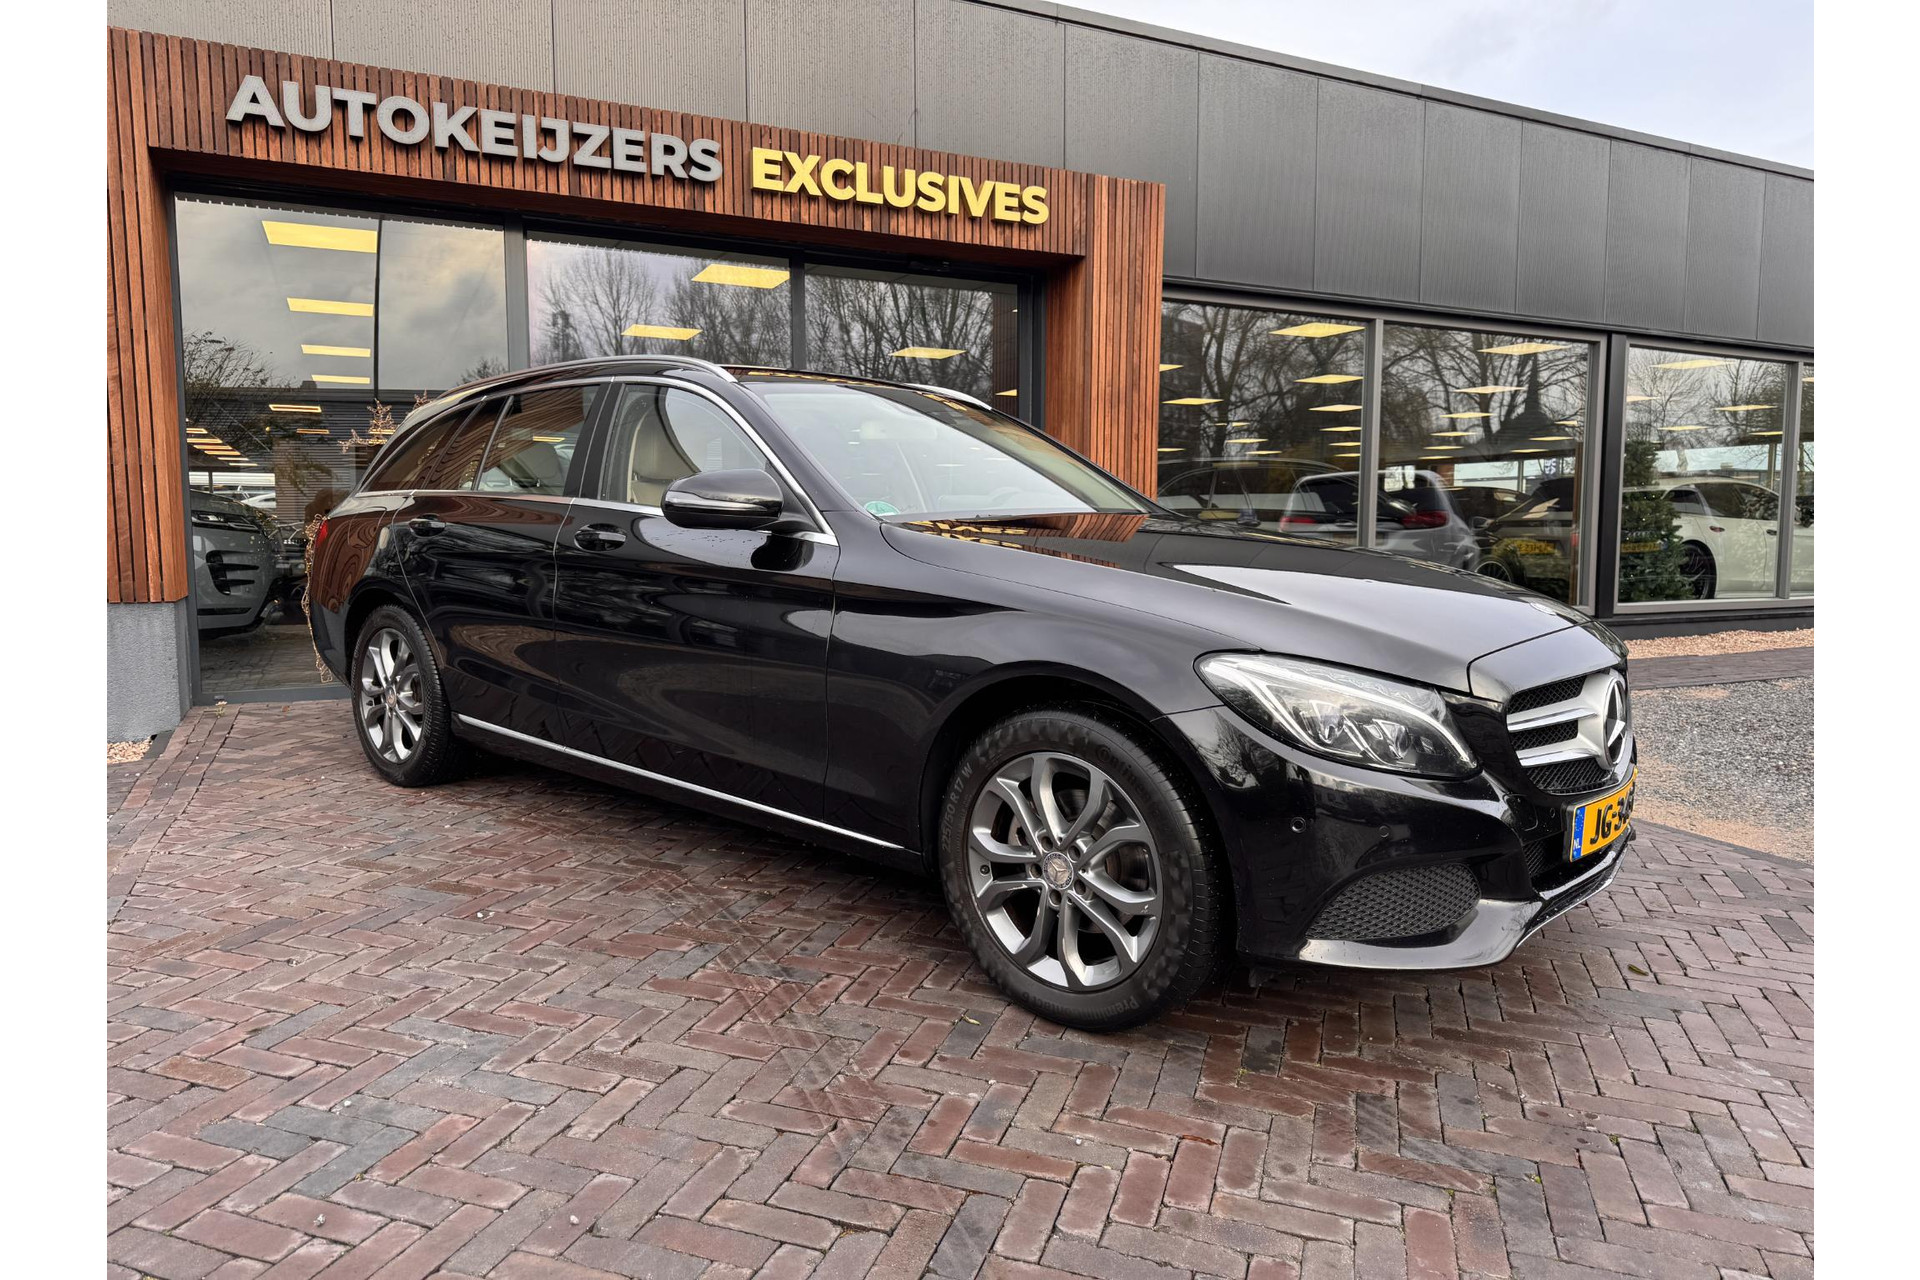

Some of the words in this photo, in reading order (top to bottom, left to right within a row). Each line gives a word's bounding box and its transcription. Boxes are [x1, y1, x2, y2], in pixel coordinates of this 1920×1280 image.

[225, 74, 723, 183] AUTOKEIJZERS
[752, 146, 1050, 226] EXCLUSIVES
[941, 802, 956, 853] 225/50
